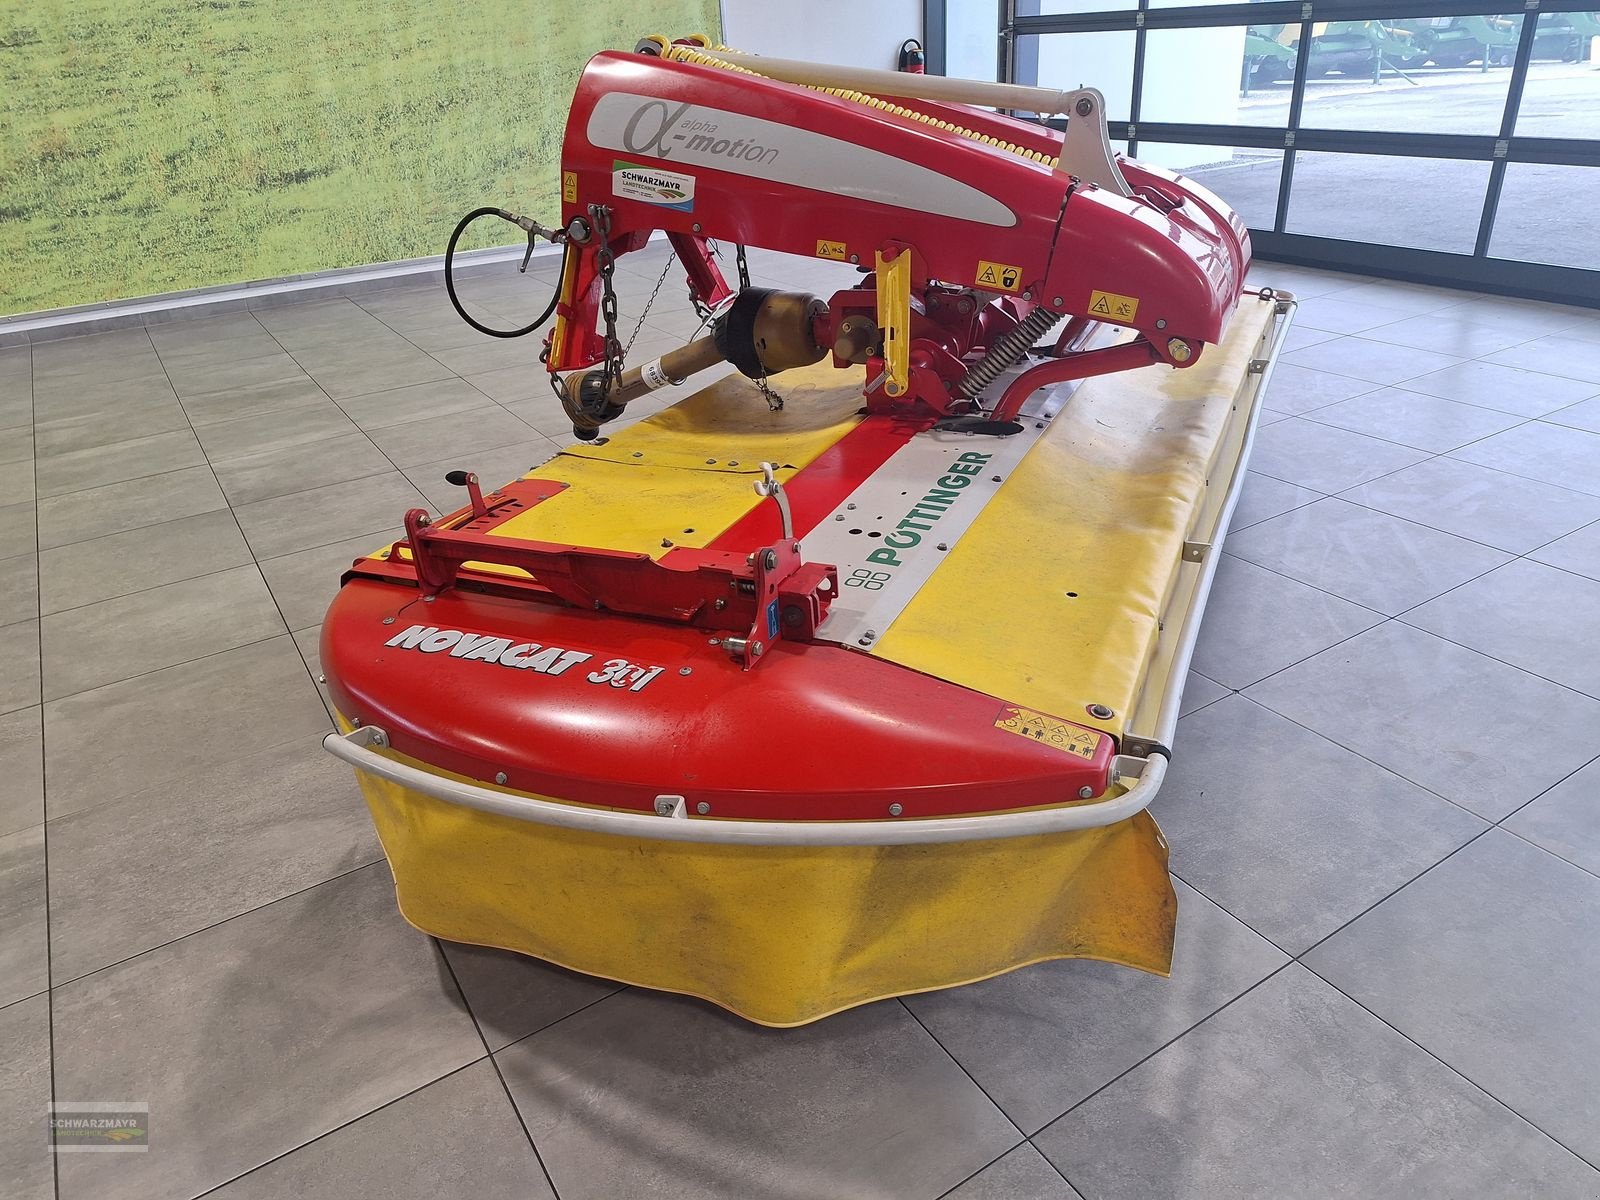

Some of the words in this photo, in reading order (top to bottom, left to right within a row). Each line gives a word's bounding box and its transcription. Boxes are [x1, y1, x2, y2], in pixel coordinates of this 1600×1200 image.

[681, 117, 718, 133] alpha
[621, 171, 681, 191] SCHWARZMAYR
[865, 451, 993, 567] PÖTTINGER
[384, 625, 593, 675] NOVACAT
